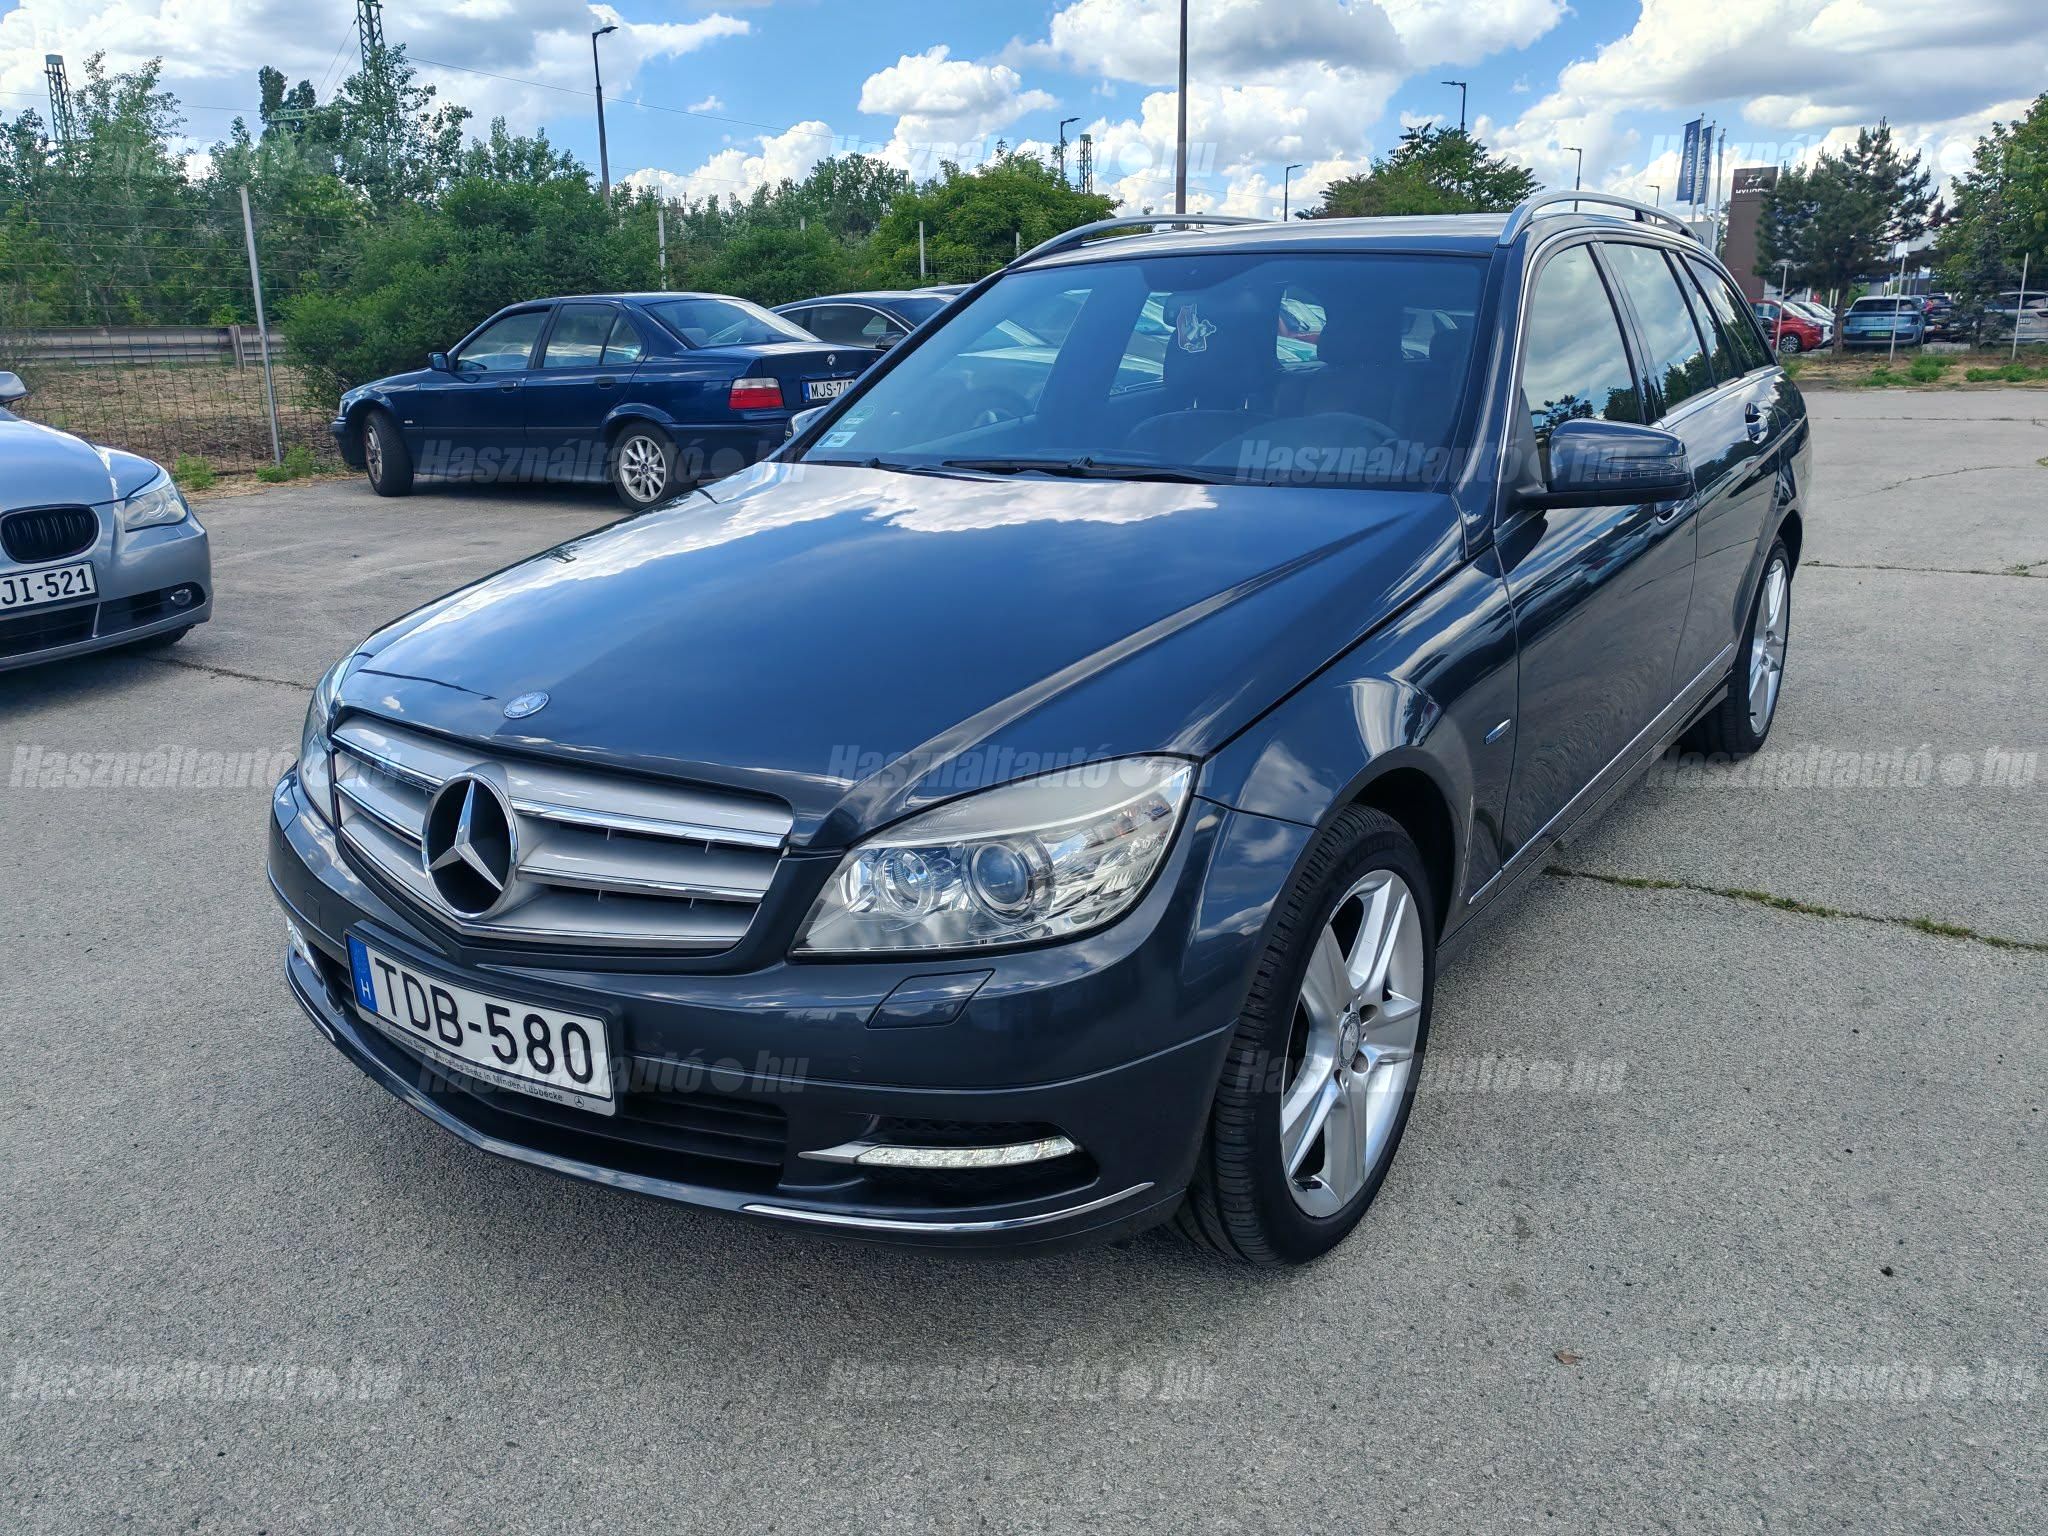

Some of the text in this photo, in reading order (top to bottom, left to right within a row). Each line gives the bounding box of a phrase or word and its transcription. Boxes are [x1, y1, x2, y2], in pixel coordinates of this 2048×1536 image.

[2, 568, 91, 605] JI-521
[360, 978, 372, 1000] H
[374, 957, 594, 1084] TDB-580
